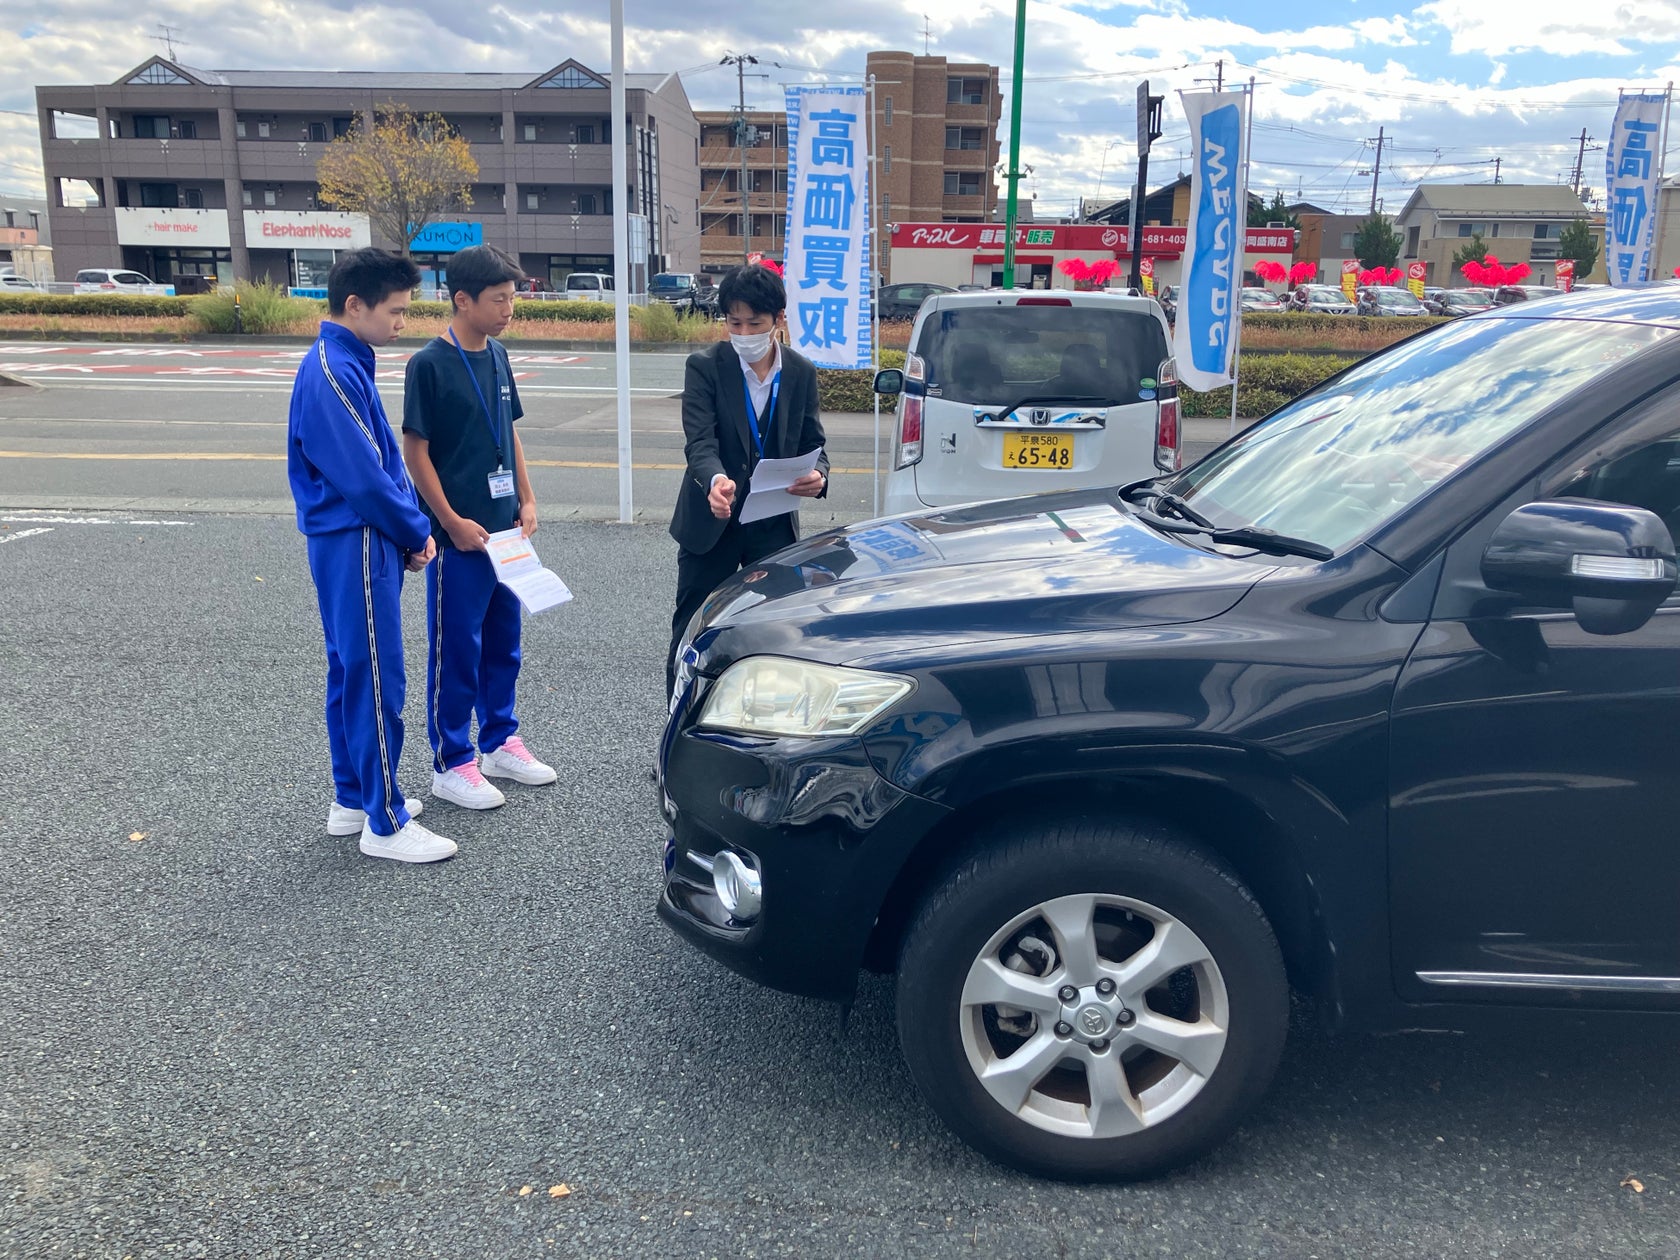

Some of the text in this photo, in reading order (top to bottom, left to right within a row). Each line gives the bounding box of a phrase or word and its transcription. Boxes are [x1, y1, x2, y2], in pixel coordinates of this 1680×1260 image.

[153, 222, 198, 233] hair make
[262, 222, 352, 238] Elephant Nose
[1018, 447, 1069, 466] 65-48
